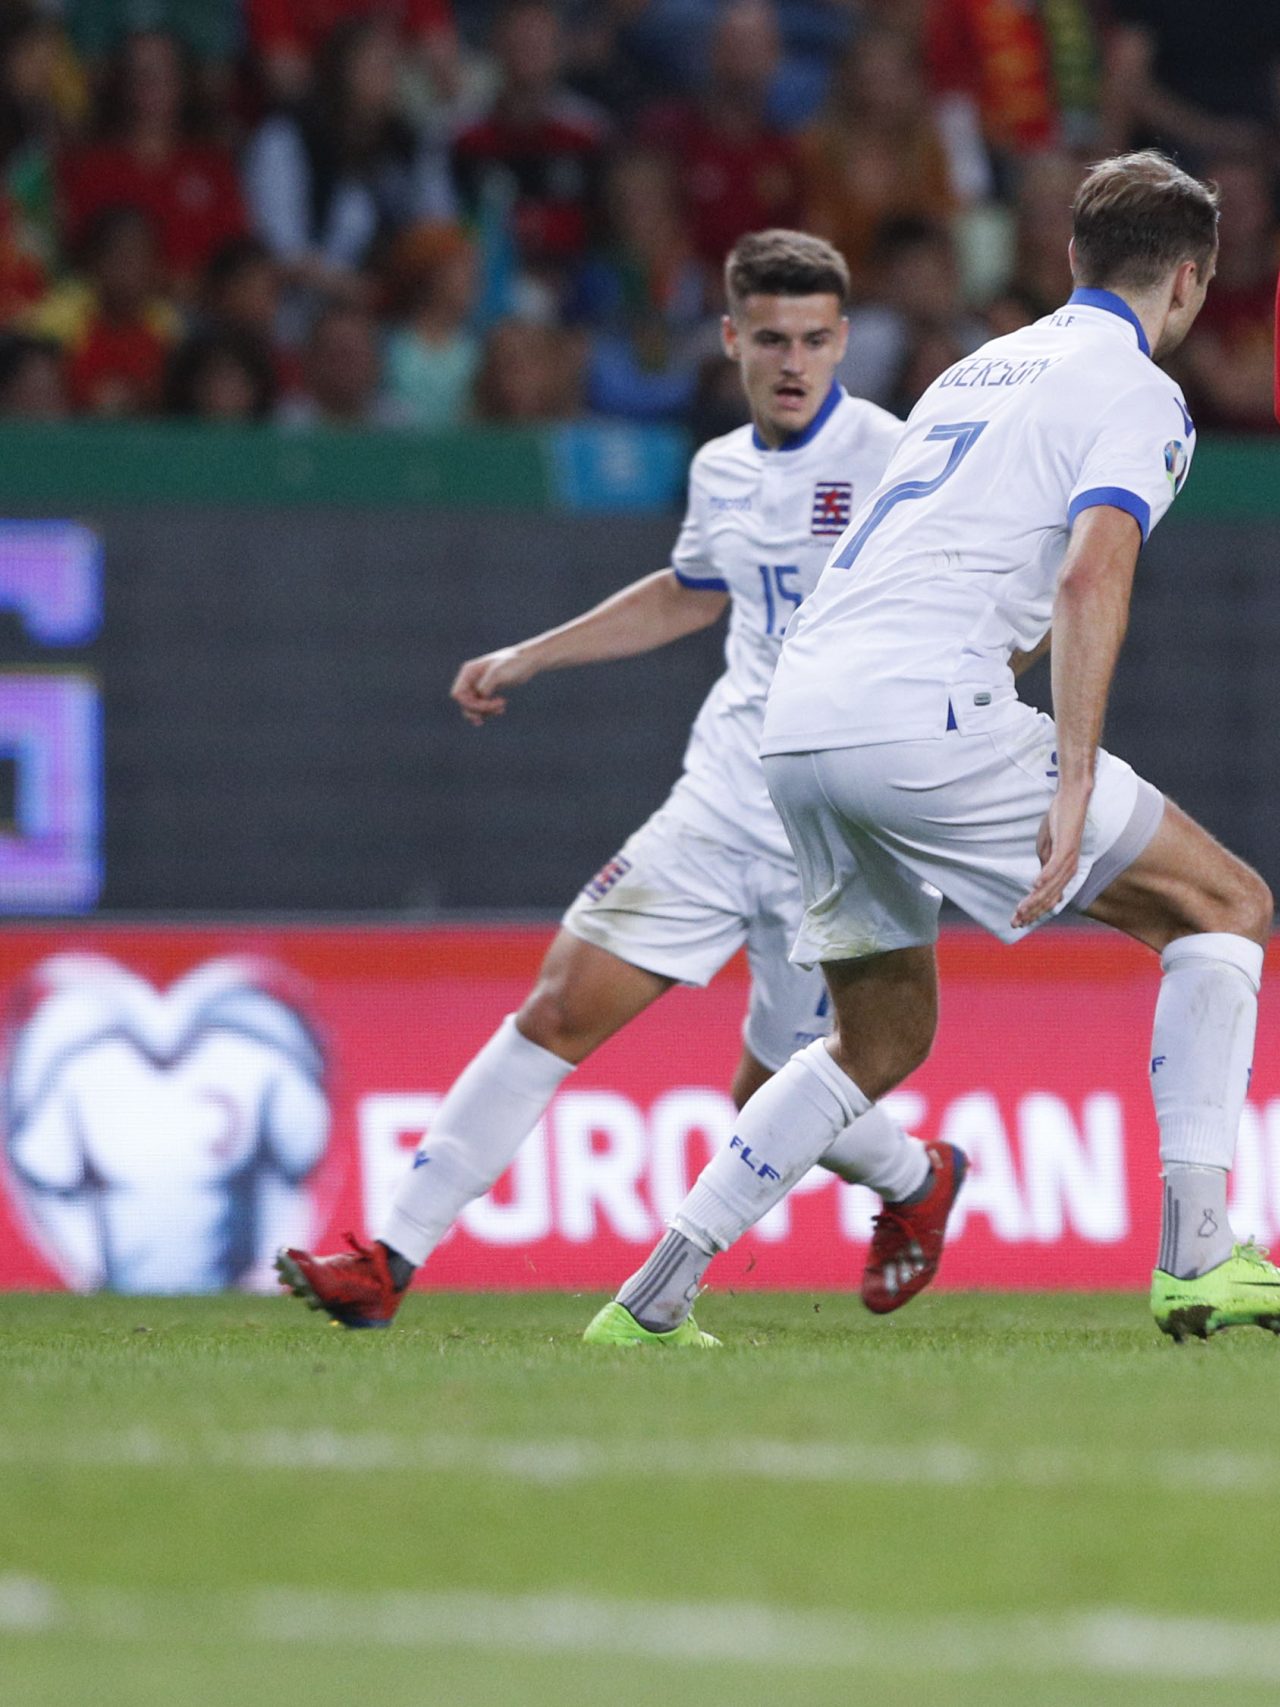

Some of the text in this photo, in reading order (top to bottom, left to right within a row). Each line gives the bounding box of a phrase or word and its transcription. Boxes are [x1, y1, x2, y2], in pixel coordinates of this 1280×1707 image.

[831, 421, 990, 570] 7
[758, 565, 804, 636] 15
[356, 1090, 1127, 1243] EUROAN
[729, 1134, 781, 1181] FLF
